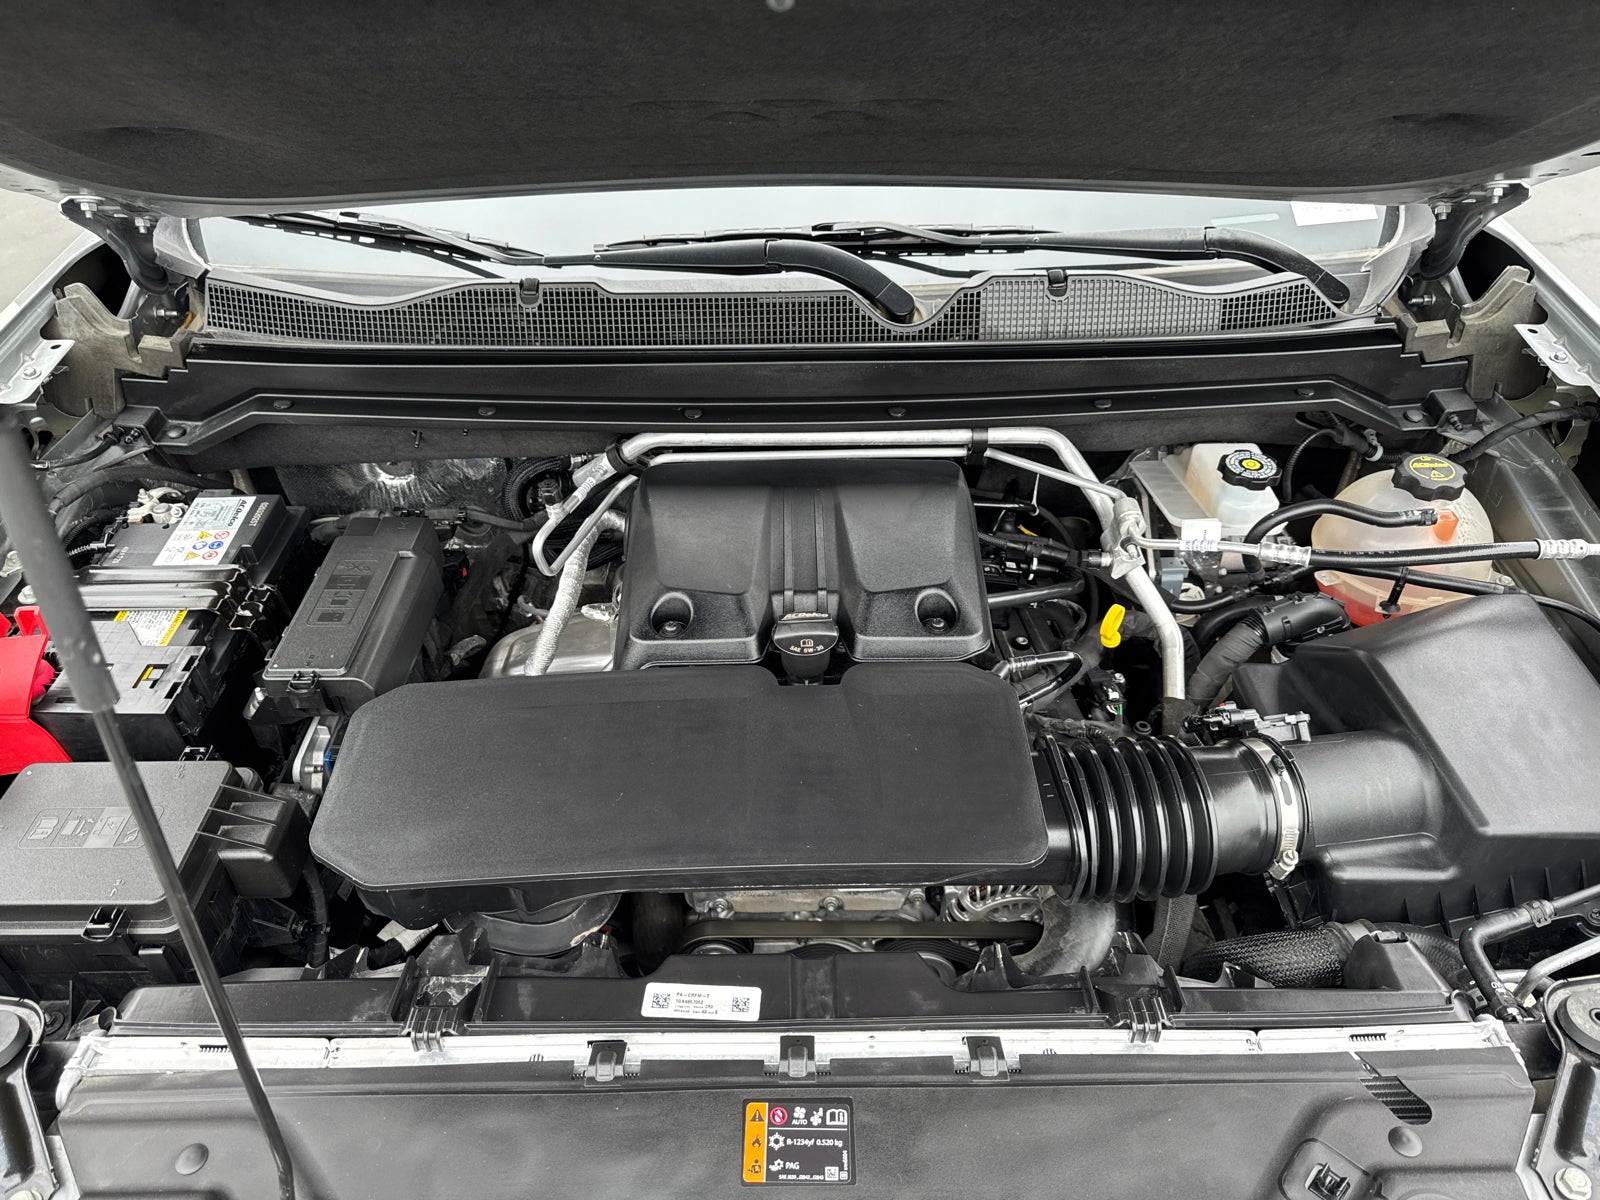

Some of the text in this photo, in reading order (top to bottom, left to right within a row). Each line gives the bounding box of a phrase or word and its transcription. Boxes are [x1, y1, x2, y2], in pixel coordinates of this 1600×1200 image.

[803, 645, 824, 653] 5W-30
[786, 1138, 815, 1147] R-1234yf
[834, 1138, 843, 1148] kg
